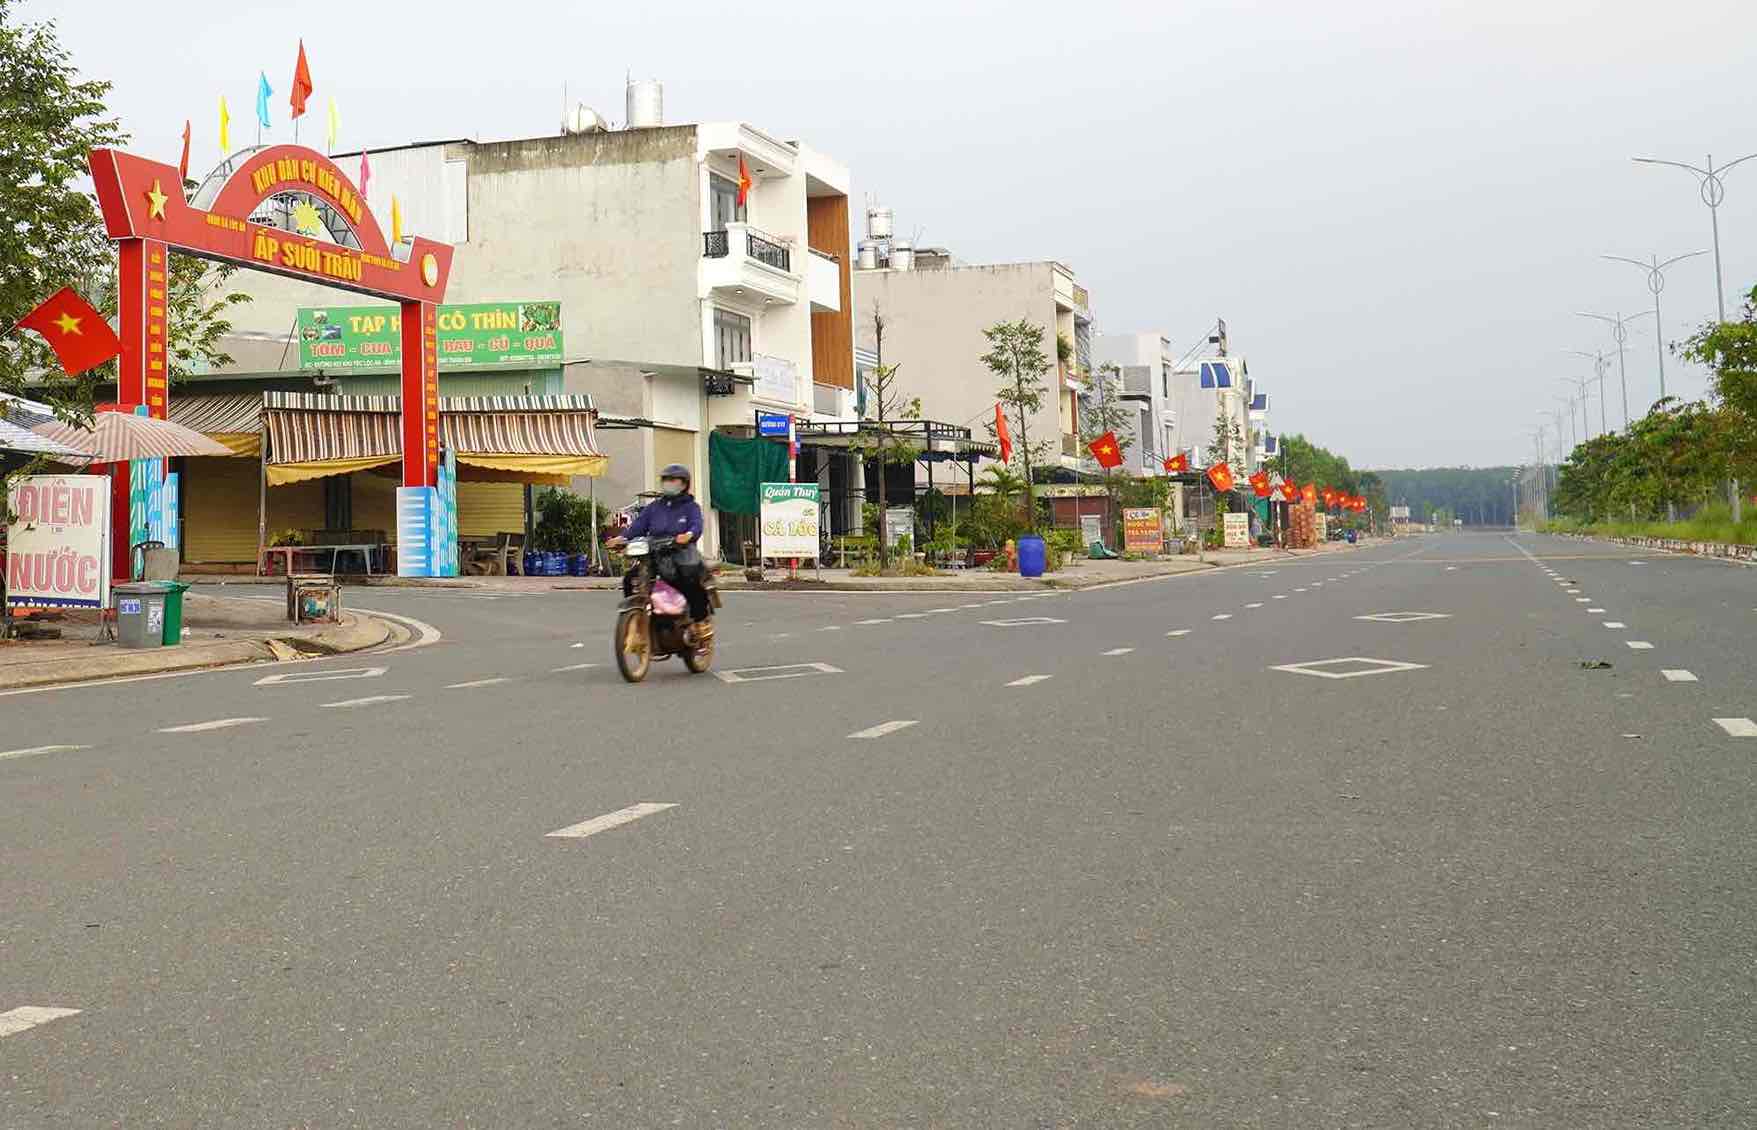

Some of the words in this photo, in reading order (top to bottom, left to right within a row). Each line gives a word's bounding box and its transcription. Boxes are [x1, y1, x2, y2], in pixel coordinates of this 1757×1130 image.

[252, 163, 277, 193] KHU
[253, 227, 279, 261] ẤP
[281, 240, 320, 272] SUỐI
[351, 315, 385, 336] TẠP
[438, 310, 466, 331] CÔ
[311, 341, 346, 356] TÔM
[360, 342, 392, 356] CUA
[16, 479, 95, 532] ĐIỆN
[764, 485, 791, 498] Quán
[9, 545, 97, 594] NƯỚC
